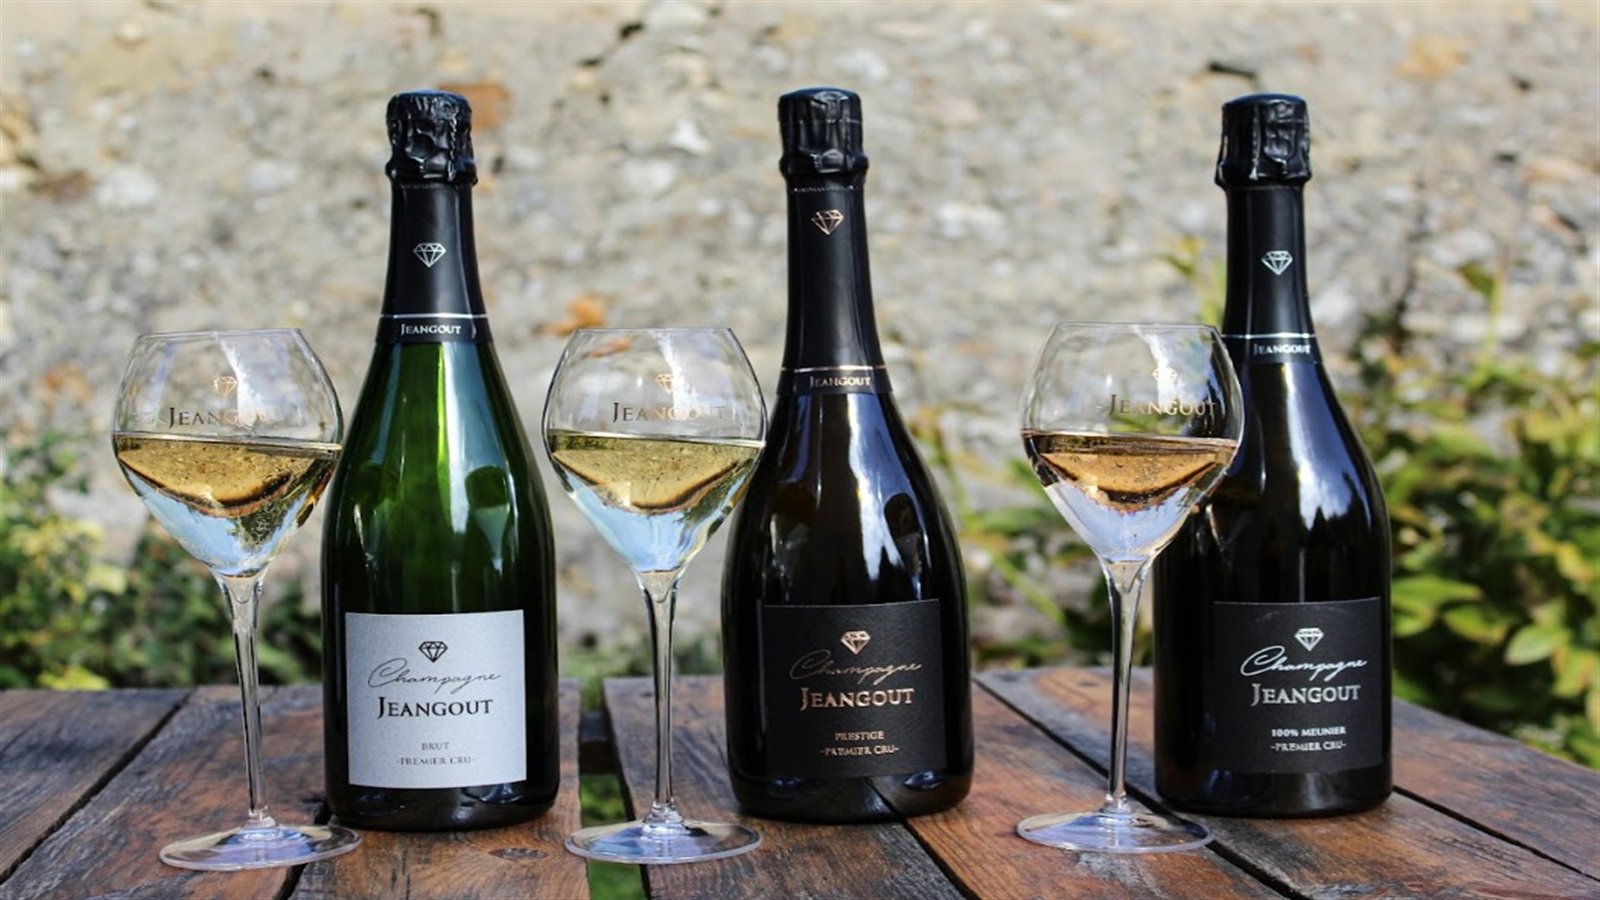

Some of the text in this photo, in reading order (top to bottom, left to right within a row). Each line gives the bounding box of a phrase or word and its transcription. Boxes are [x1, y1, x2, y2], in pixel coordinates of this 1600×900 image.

[401, 323, 462, 336] JEANGOUT
[1253, 342, 1311, 356] JEANGOUT
[809, 375, 871, 388] JEANGOUT
[789, 649, 923, 686] Champagne
[1240, 645, 1368, 682] Champagne
[367, 657, 501, 694] Champagne
[800, 687, 915, 711] JEANGOUT
[1251, 683, 1361, 707] JEANGOUT
[377, 696, 494, 719] JEANGOUT
[834, 730, 885, 741] PRESTIGE
[1271, 726, 1347, 738] 100% MEUNIER
[421, 742, 451, 751] BRUT
